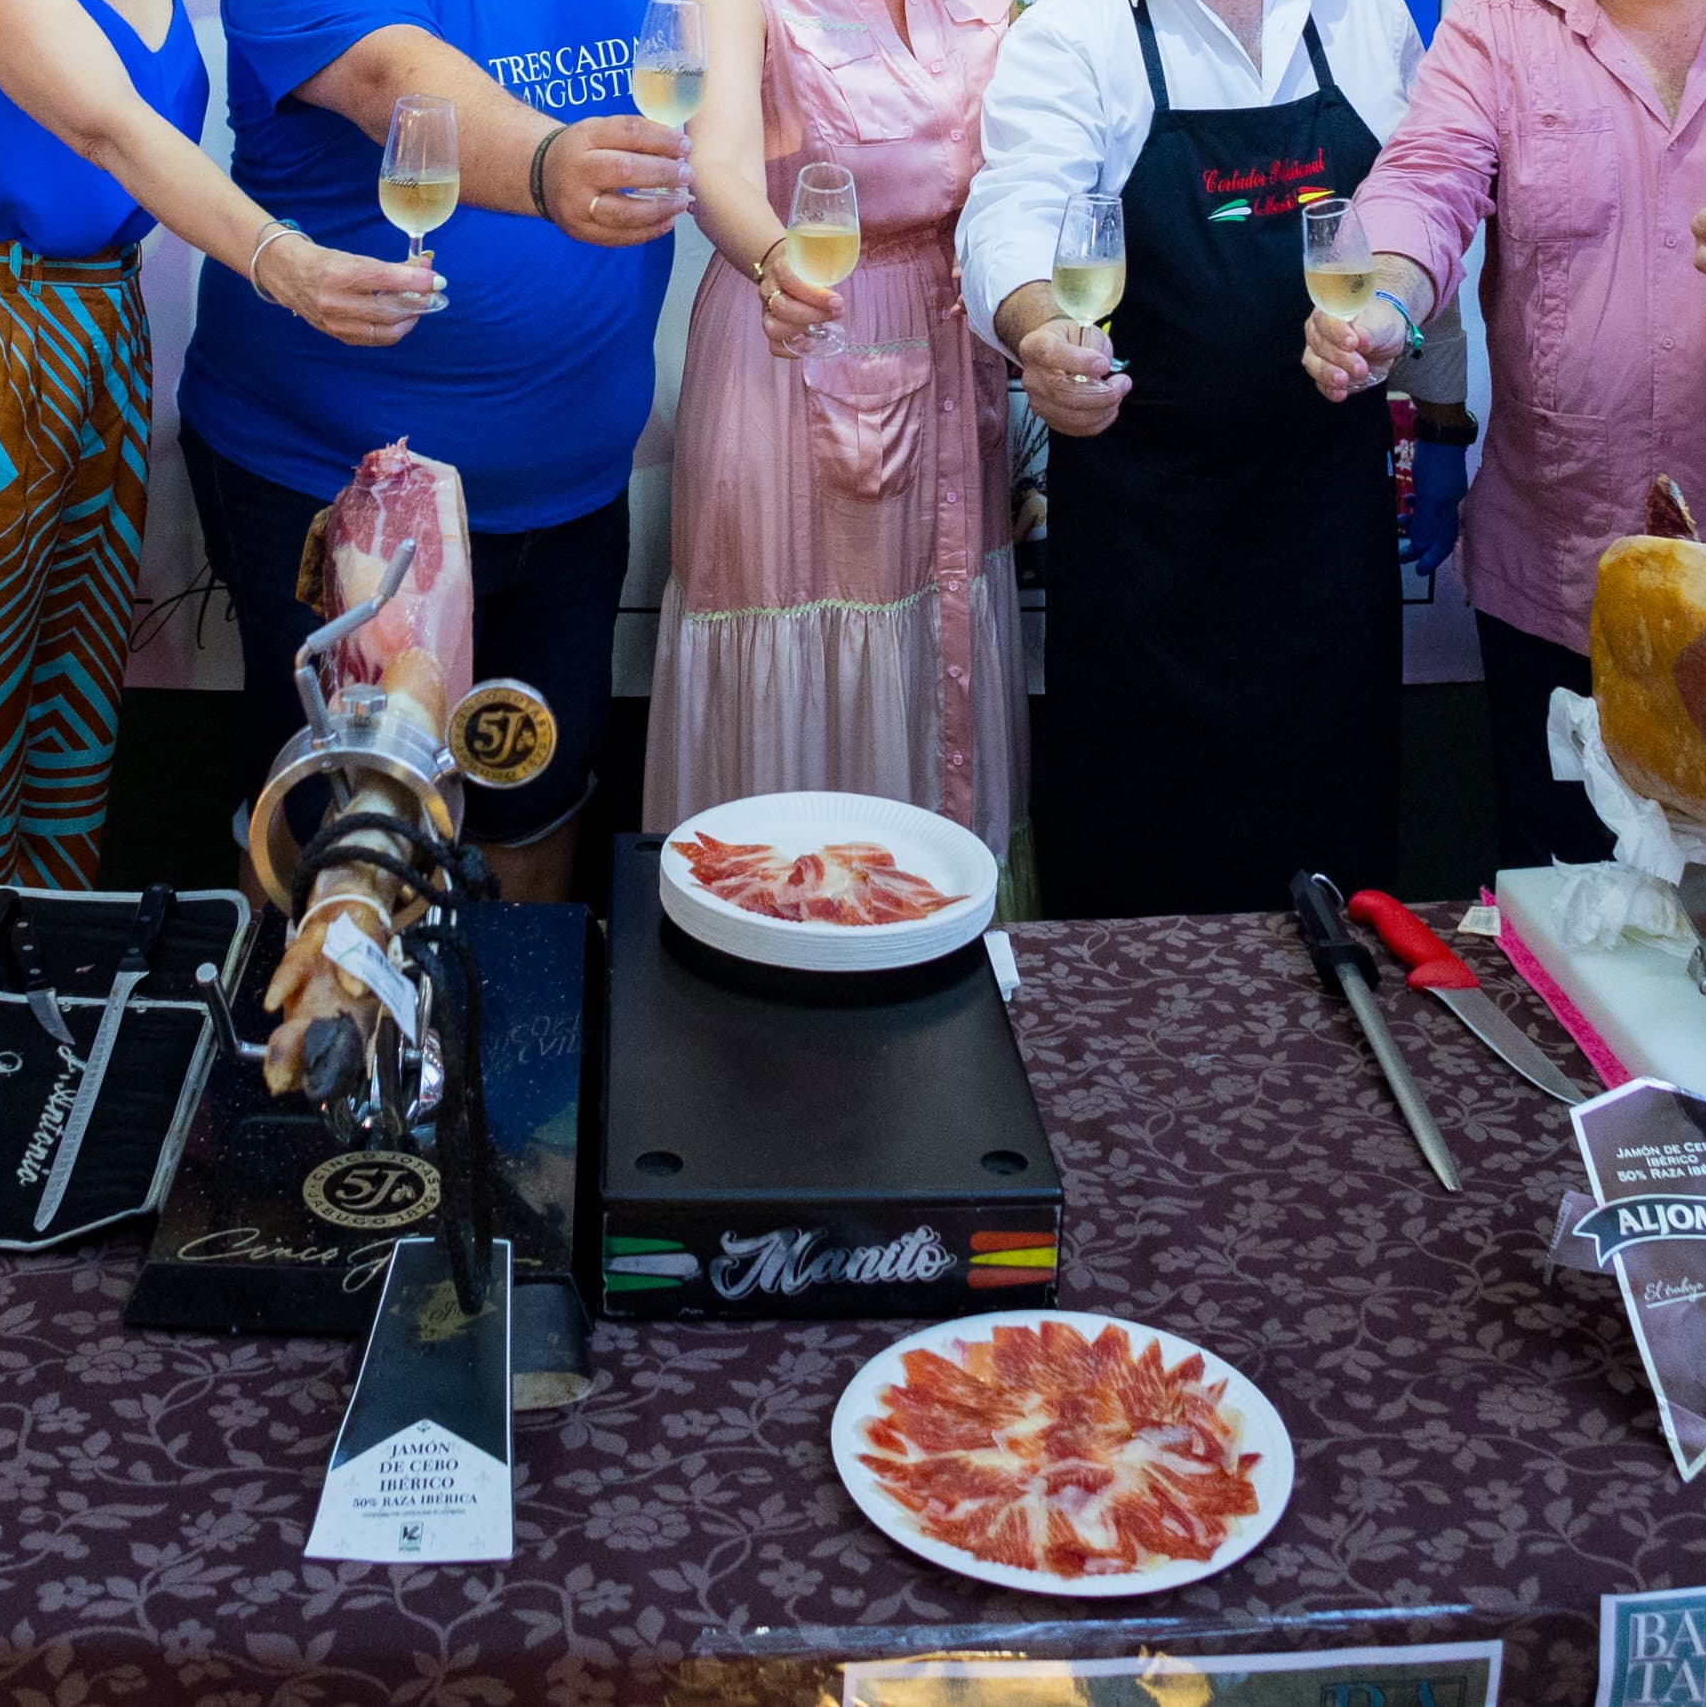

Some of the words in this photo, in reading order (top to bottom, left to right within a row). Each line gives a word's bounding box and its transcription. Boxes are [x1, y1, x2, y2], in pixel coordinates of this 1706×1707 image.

[488, 51, 552, 86] TRES
[473, 708, 528, 765] 5J
[1616, 1144, 1662, 1160] JAMÓN
[1664, 1143, 1681, 1156] DE
[1646, 1154, 1699, 1168] IBÉRICO
[312, 1152, 376, 1182] CINCO
[1617, 1168, 1647, 1183] 50%
[1650, 1166, 1686, 1180] RAZA
[335, 1167, 409, 1210] 5J
[177, 1226, 341, 1266] Cinco
[709, 1224, 959, 1302] Manito
[1643, 1279, 1663, 1302] El
[390, 1440, 451, 1460] JAMÓN
[379, 1460, 405, 1475] DE
[409, 1459, 460, 1473] CEBO
[379, 1475, 455, 1493] IBÉRICO
[352, 1496, 378, 1509] 50%
[382, 1494, 416, 1508] RAZA
[420, 1492, 478, 1506] IBÉRICA
[1627, 1660, 1705, 1705] TA
